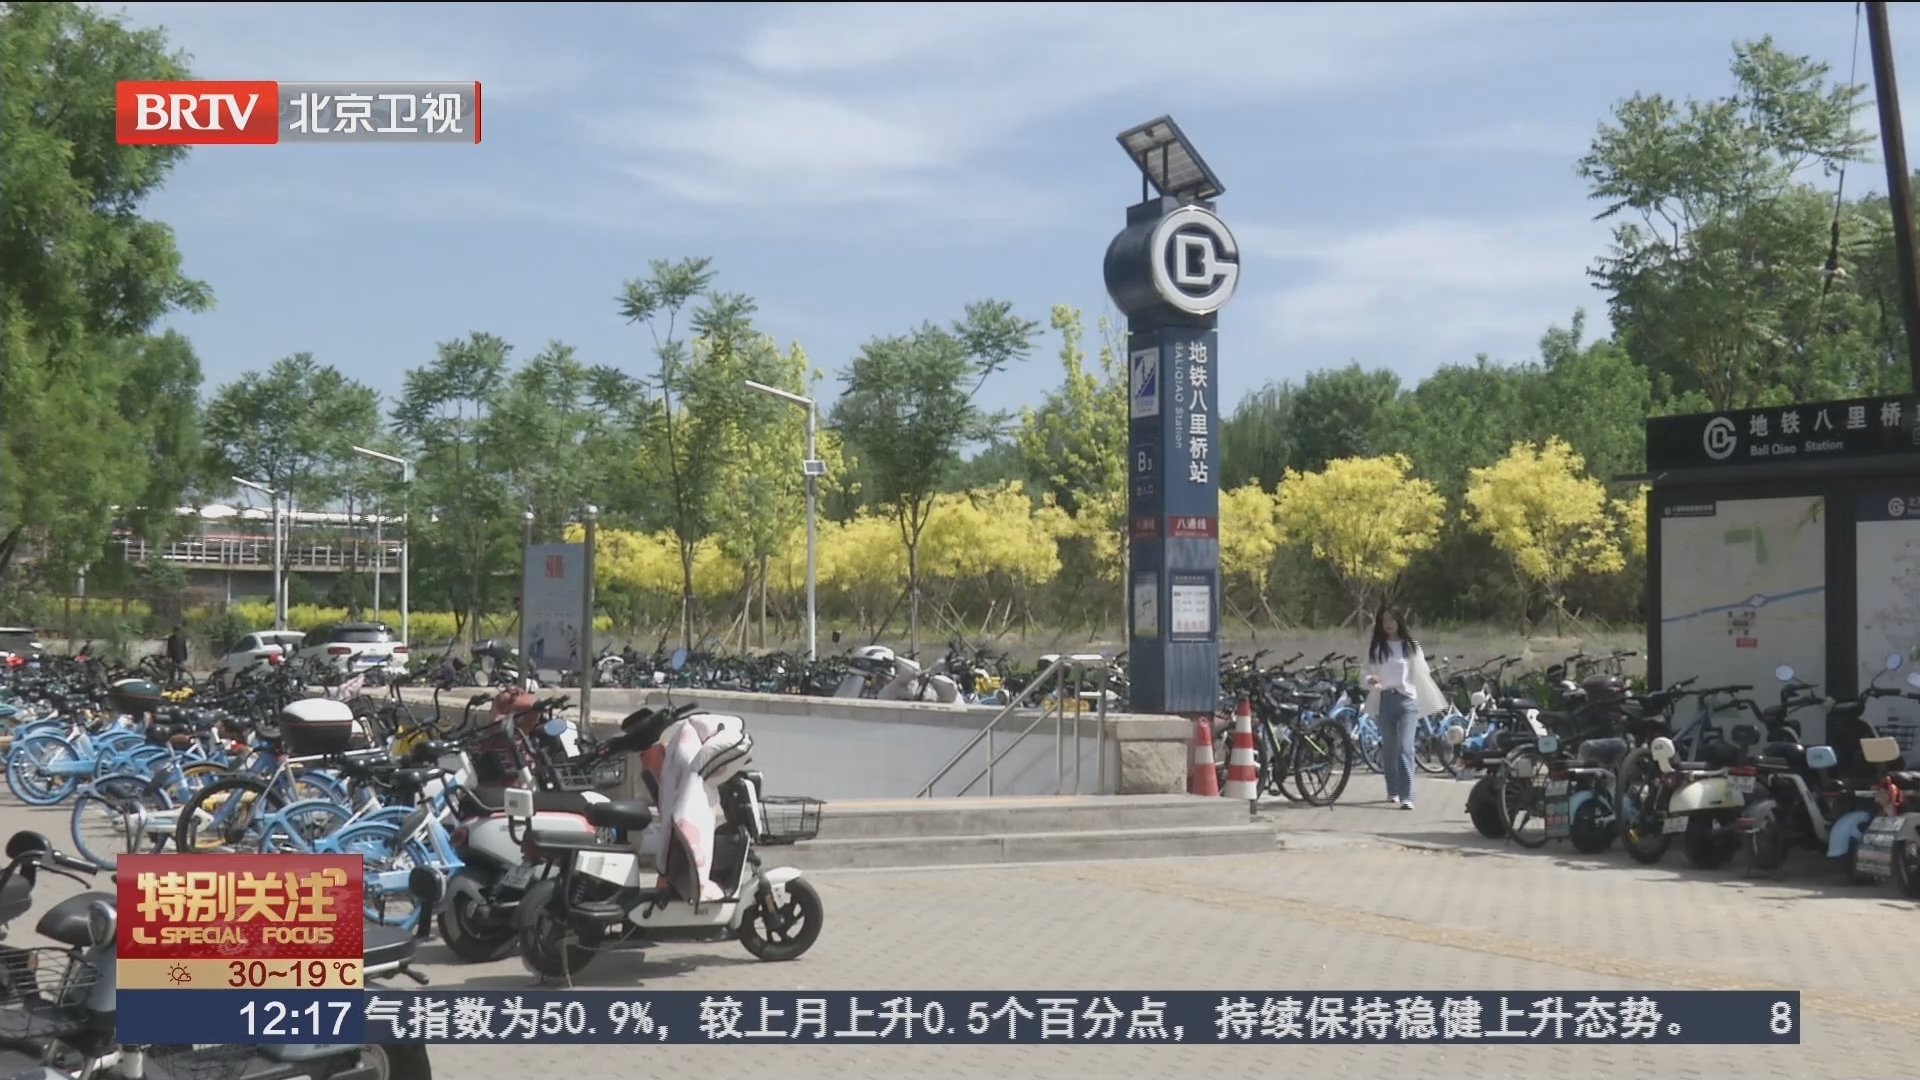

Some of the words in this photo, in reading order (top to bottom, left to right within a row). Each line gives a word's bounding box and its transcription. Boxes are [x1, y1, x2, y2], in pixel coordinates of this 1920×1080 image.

[1175, 341, 1184, 402] BALIQIAO
[1175, 408, 1183, 448] Station
[1188, 341, 1208, 484] 地铁八里桥站
[1749, 401, 1920, 437] 地铁八里桥
[1804, 440, 1844, 453] Station
